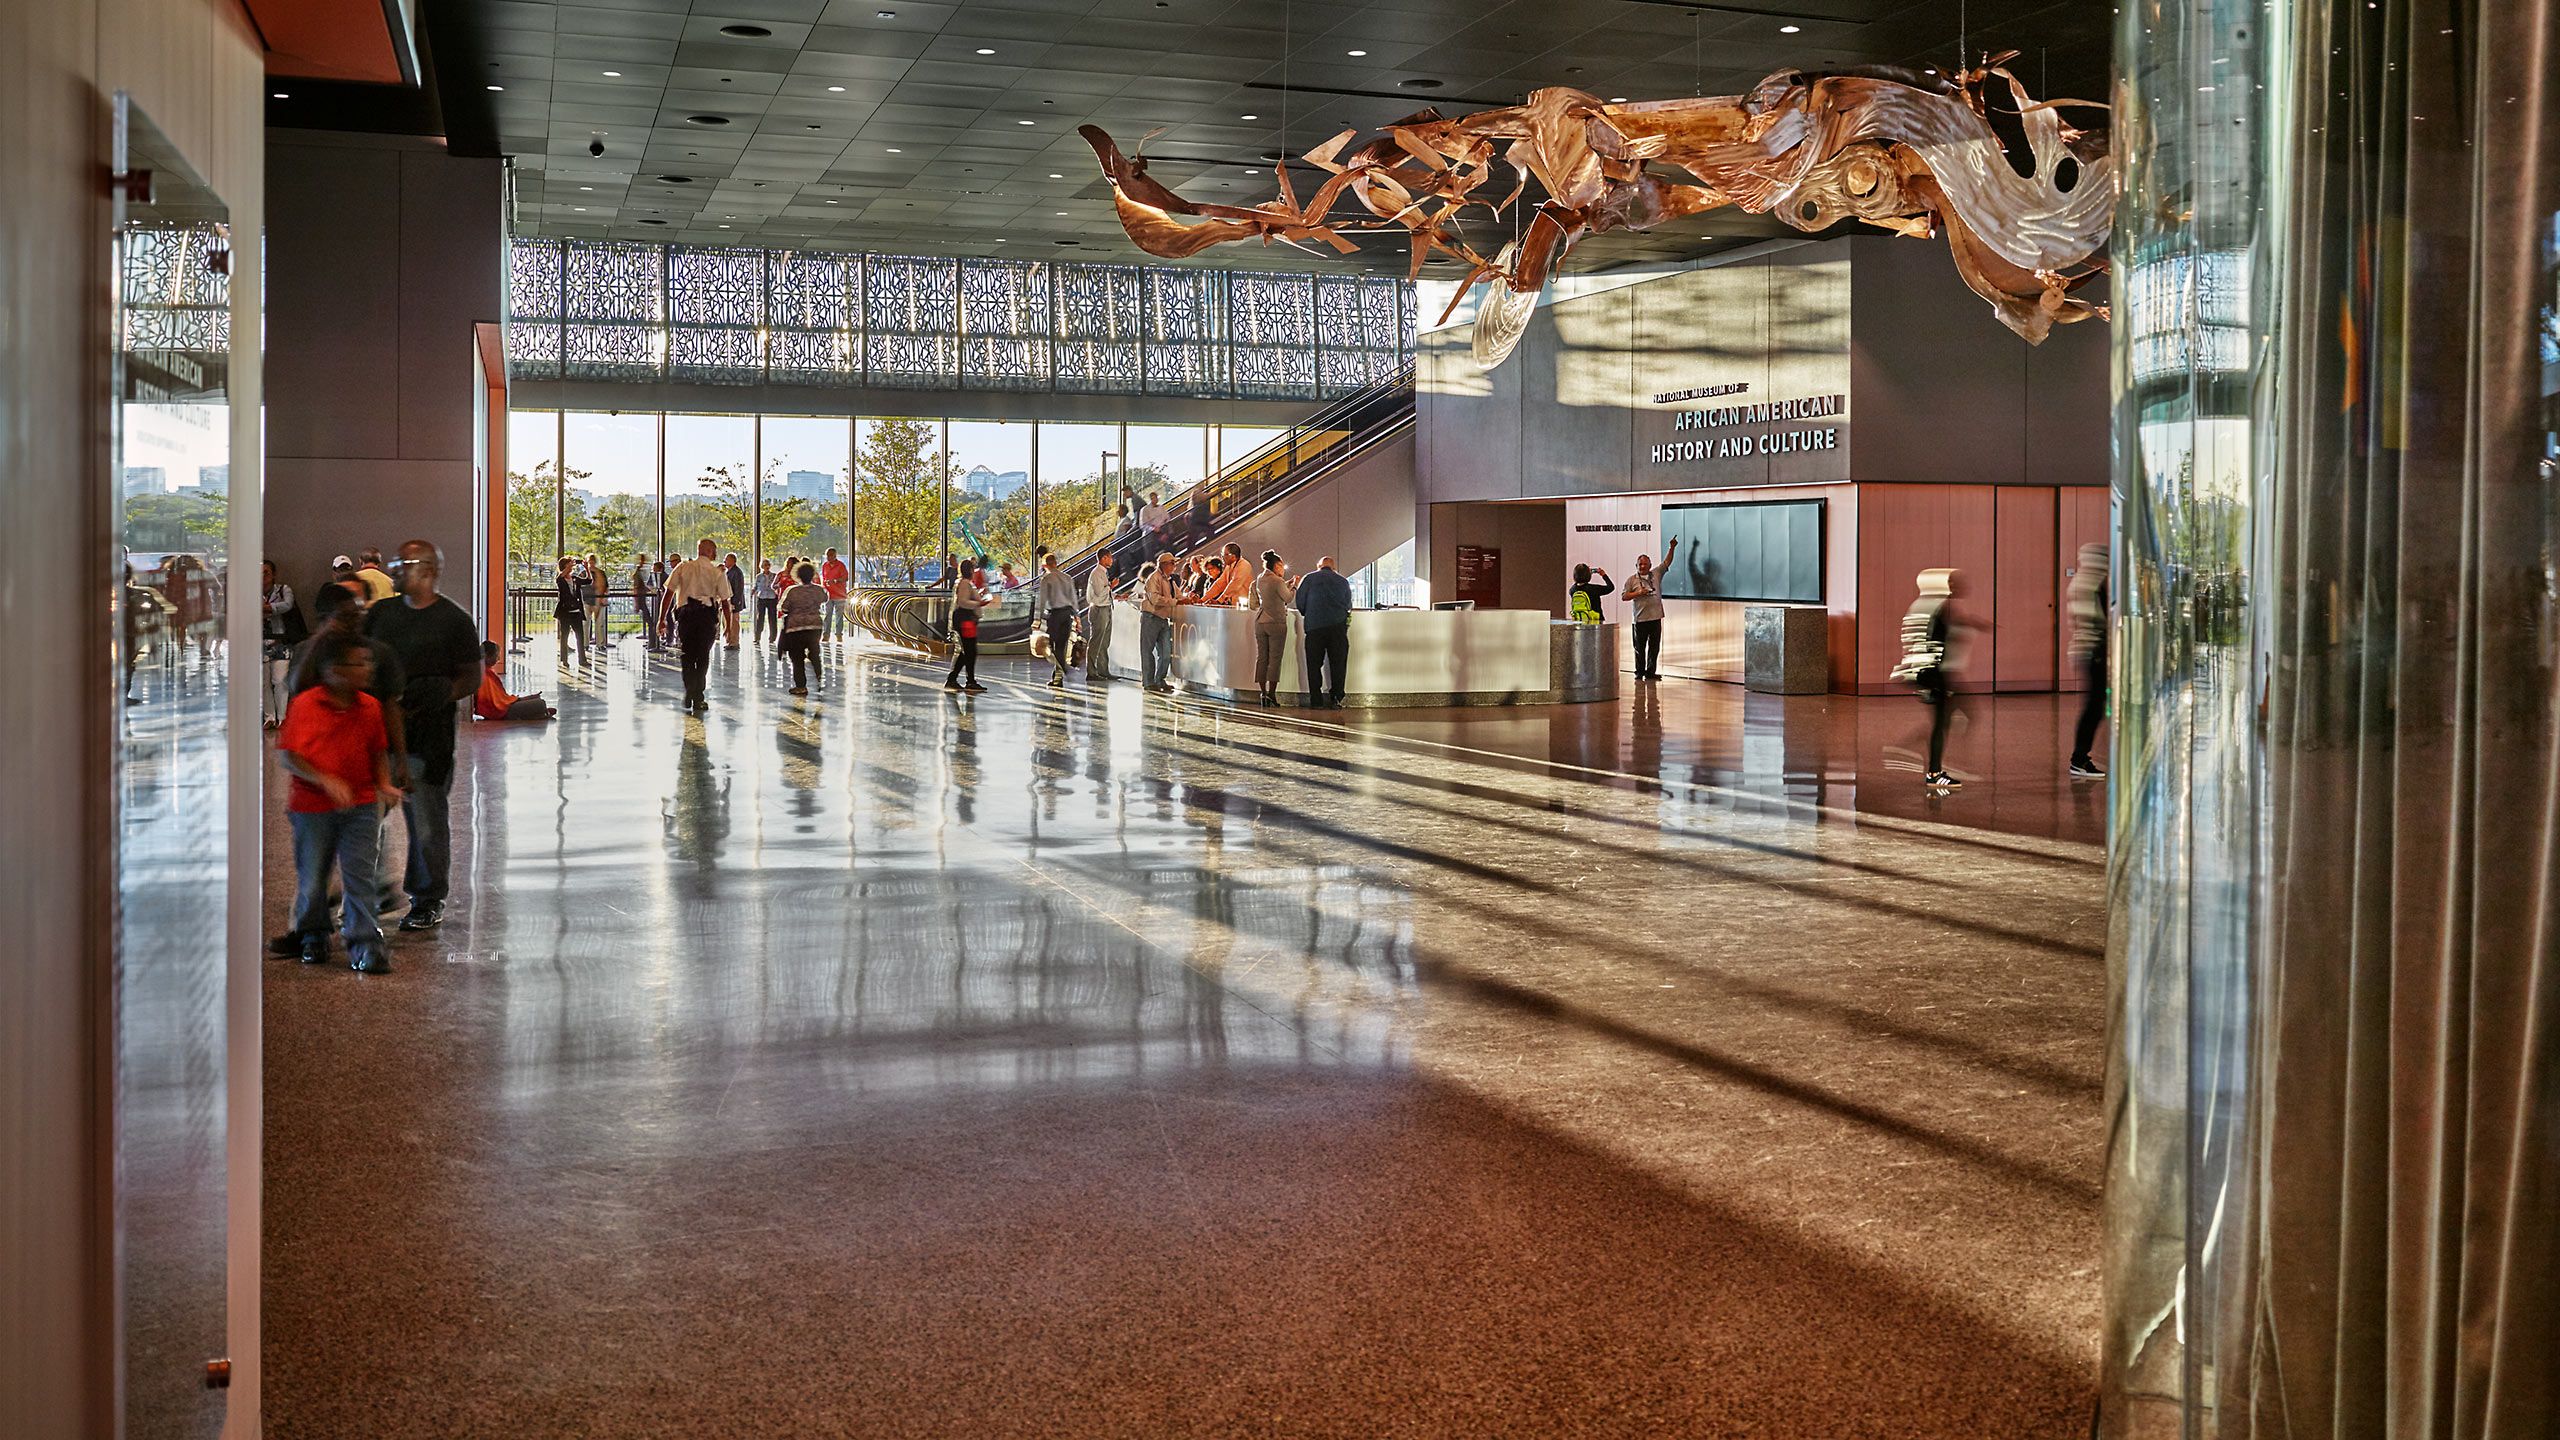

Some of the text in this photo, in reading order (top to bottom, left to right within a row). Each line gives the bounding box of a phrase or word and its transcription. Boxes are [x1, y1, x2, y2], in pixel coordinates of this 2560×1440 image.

[1653, 383, 1740, 403] NATIONAL MUSEUM OF
[1675, 395, 1836, 431] AFRICAN AMERICAN
[1651, 428, 1836, 463] HISTORY AND CULTURE
